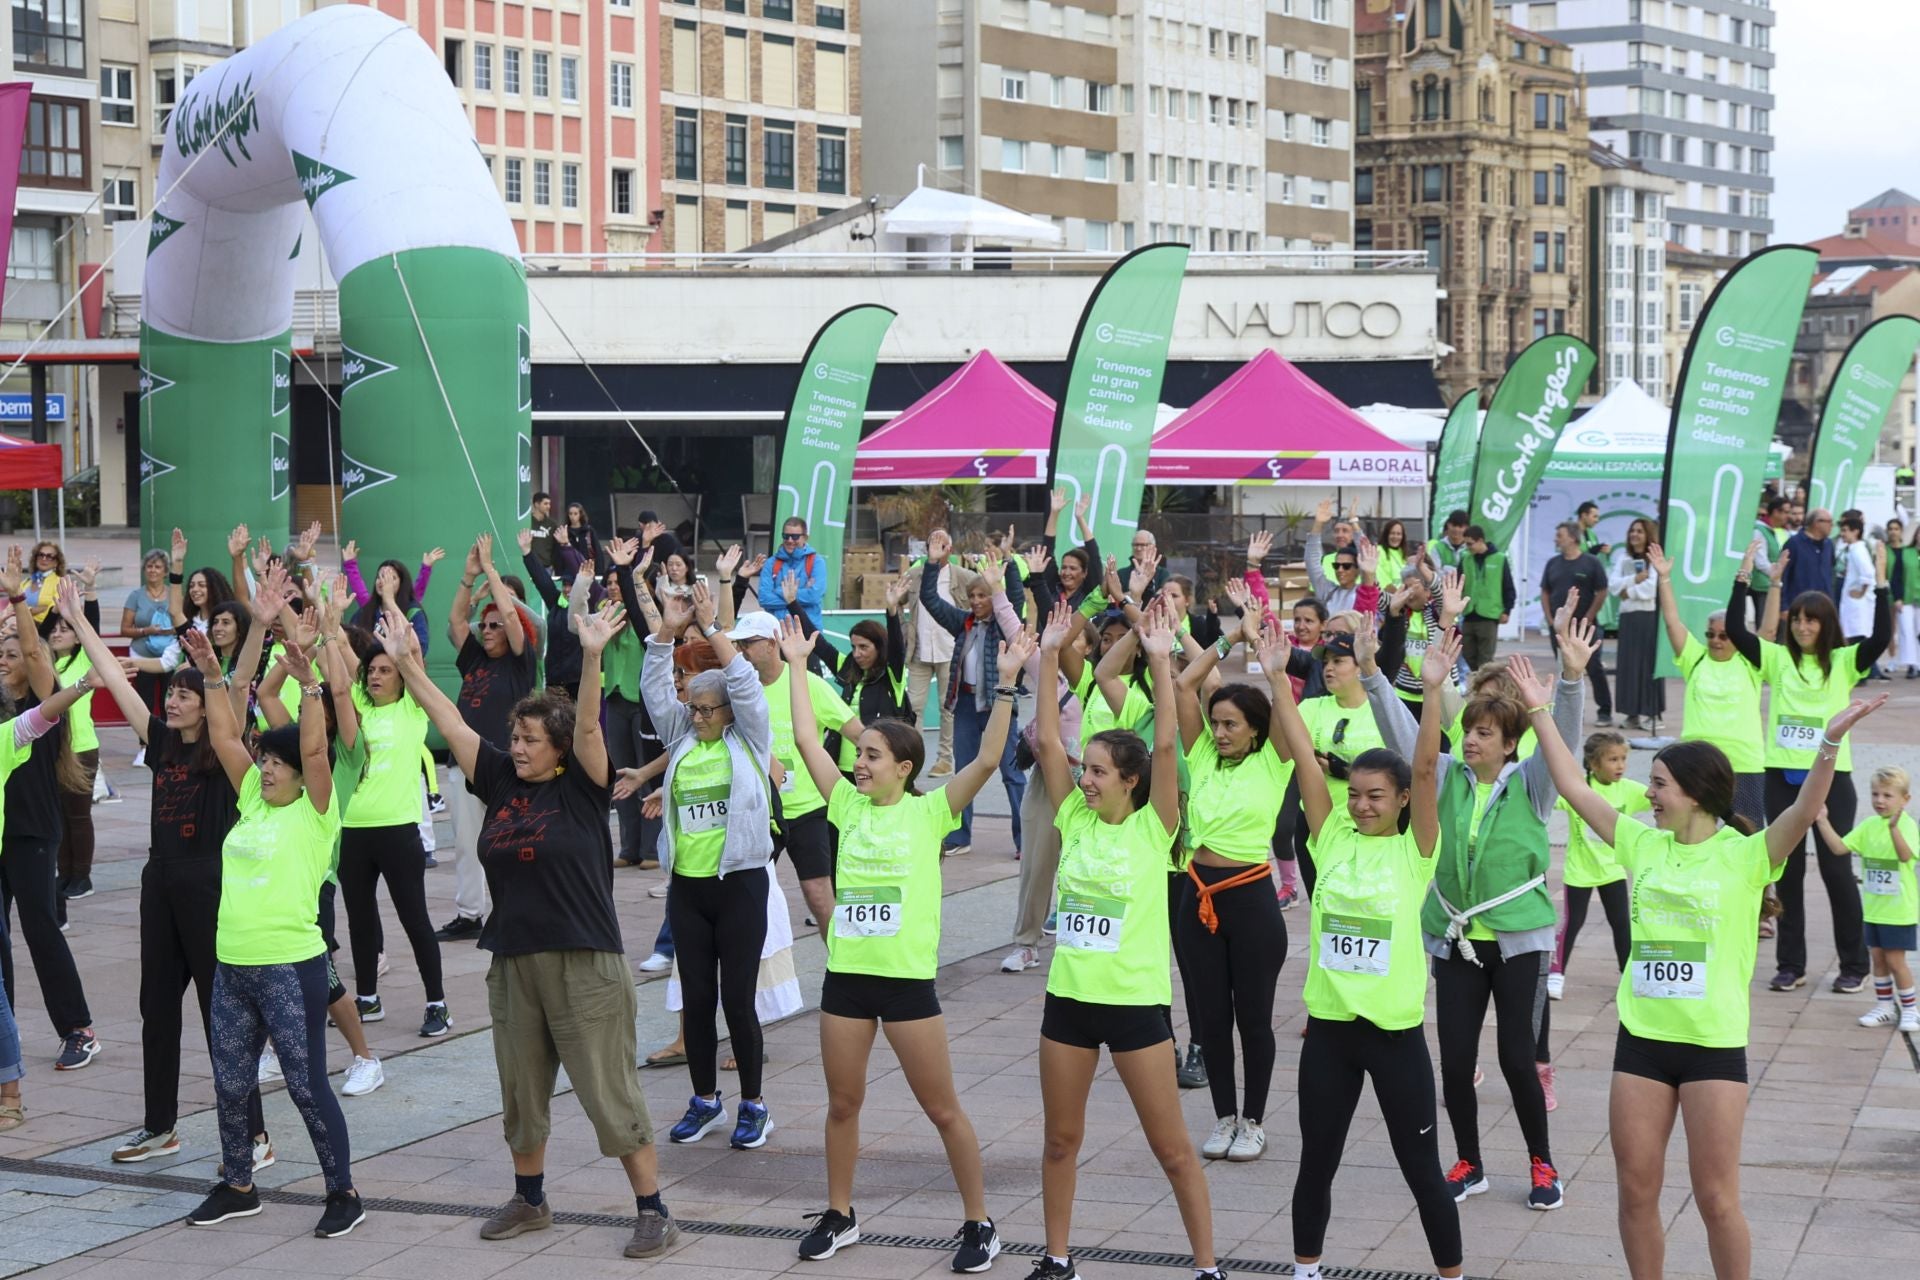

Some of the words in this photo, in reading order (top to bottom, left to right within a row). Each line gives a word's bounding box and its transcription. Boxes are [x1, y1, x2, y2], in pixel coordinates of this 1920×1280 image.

[1206, 301, 1401, 339] NAUTICO
[1095, 357, 1153, 378] Tenemos
[1706, 362, 1770, 388] Tenemos
[1092, 373, 1108, 385] un
[1110, 376, 1139, 390] gran
[1701, 380, 1721, 393] un
[1722, 384, 1755, 400] gran
[812, 390, 857, 410] Tenemos
[1088, 387, 1135, 403] camino
[1517, 346, 1579, 440] Inglés
[809, 402, 822, 414] un
[823, 405, 847, 419] gran
[1085, 401, 1108, 413] por
[1698, 397, 1749, 416] camino
[806, 415, 843, 429] camino
[1084, 414, 1133, 431] delante
[1694, 413, 1720, 427] por
[803, 425, 822, 437] por
[1692, 428, 1745, 449] delante
[801, 437, 841, 451] delante
[1338, 458, 1424, 472] LABORAL
[1497, 433, 1541, 495] Corte
[1547, 459, 1602, 473] OCIACIÓN
[1604, 460, 1665, 473] ESPAÑOLA
[1481, 491, 1512, 522] El
[1781, 726, 1815, 740] 0759
[688, 800, 728, 820] 1718
[1631, 866, 1653, 925] ASTURIAS
[845, 904, 891, 923] 1616
[1065, 913, 1111, 936] 1610
[1331, 935, 1380, 958] 1617
[1642, 961, 1694, 982] 1609
